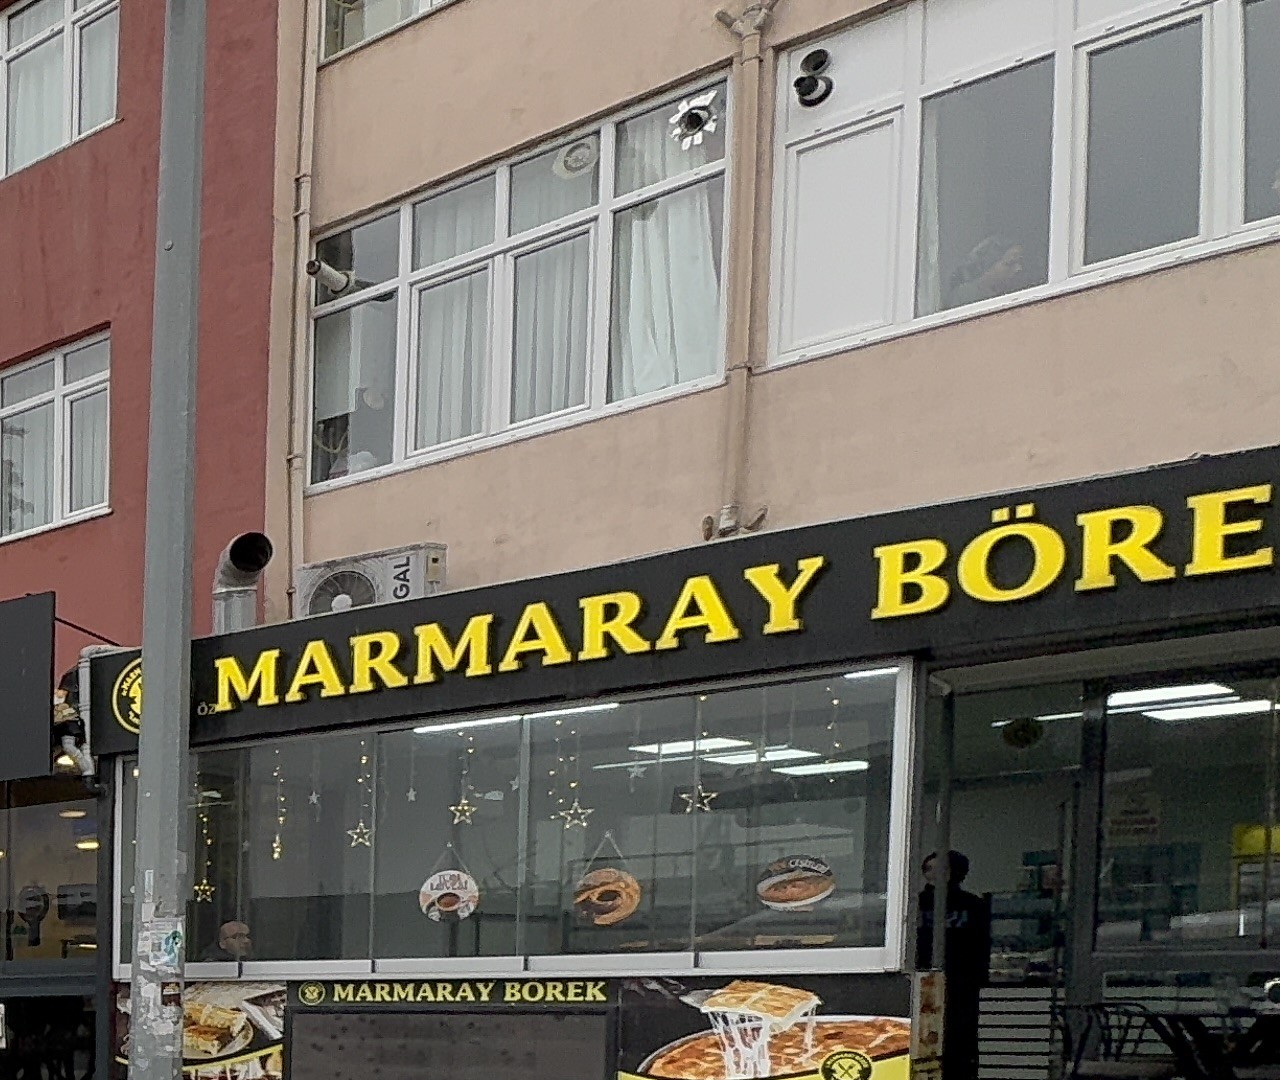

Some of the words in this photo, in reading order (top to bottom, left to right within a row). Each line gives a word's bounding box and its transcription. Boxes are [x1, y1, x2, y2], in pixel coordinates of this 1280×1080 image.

[214, 555, 826, 713] MARMARAY
[871, 484, 1274, 622] BÖRE
[333, 982, 495, 1003] MARMARAY
